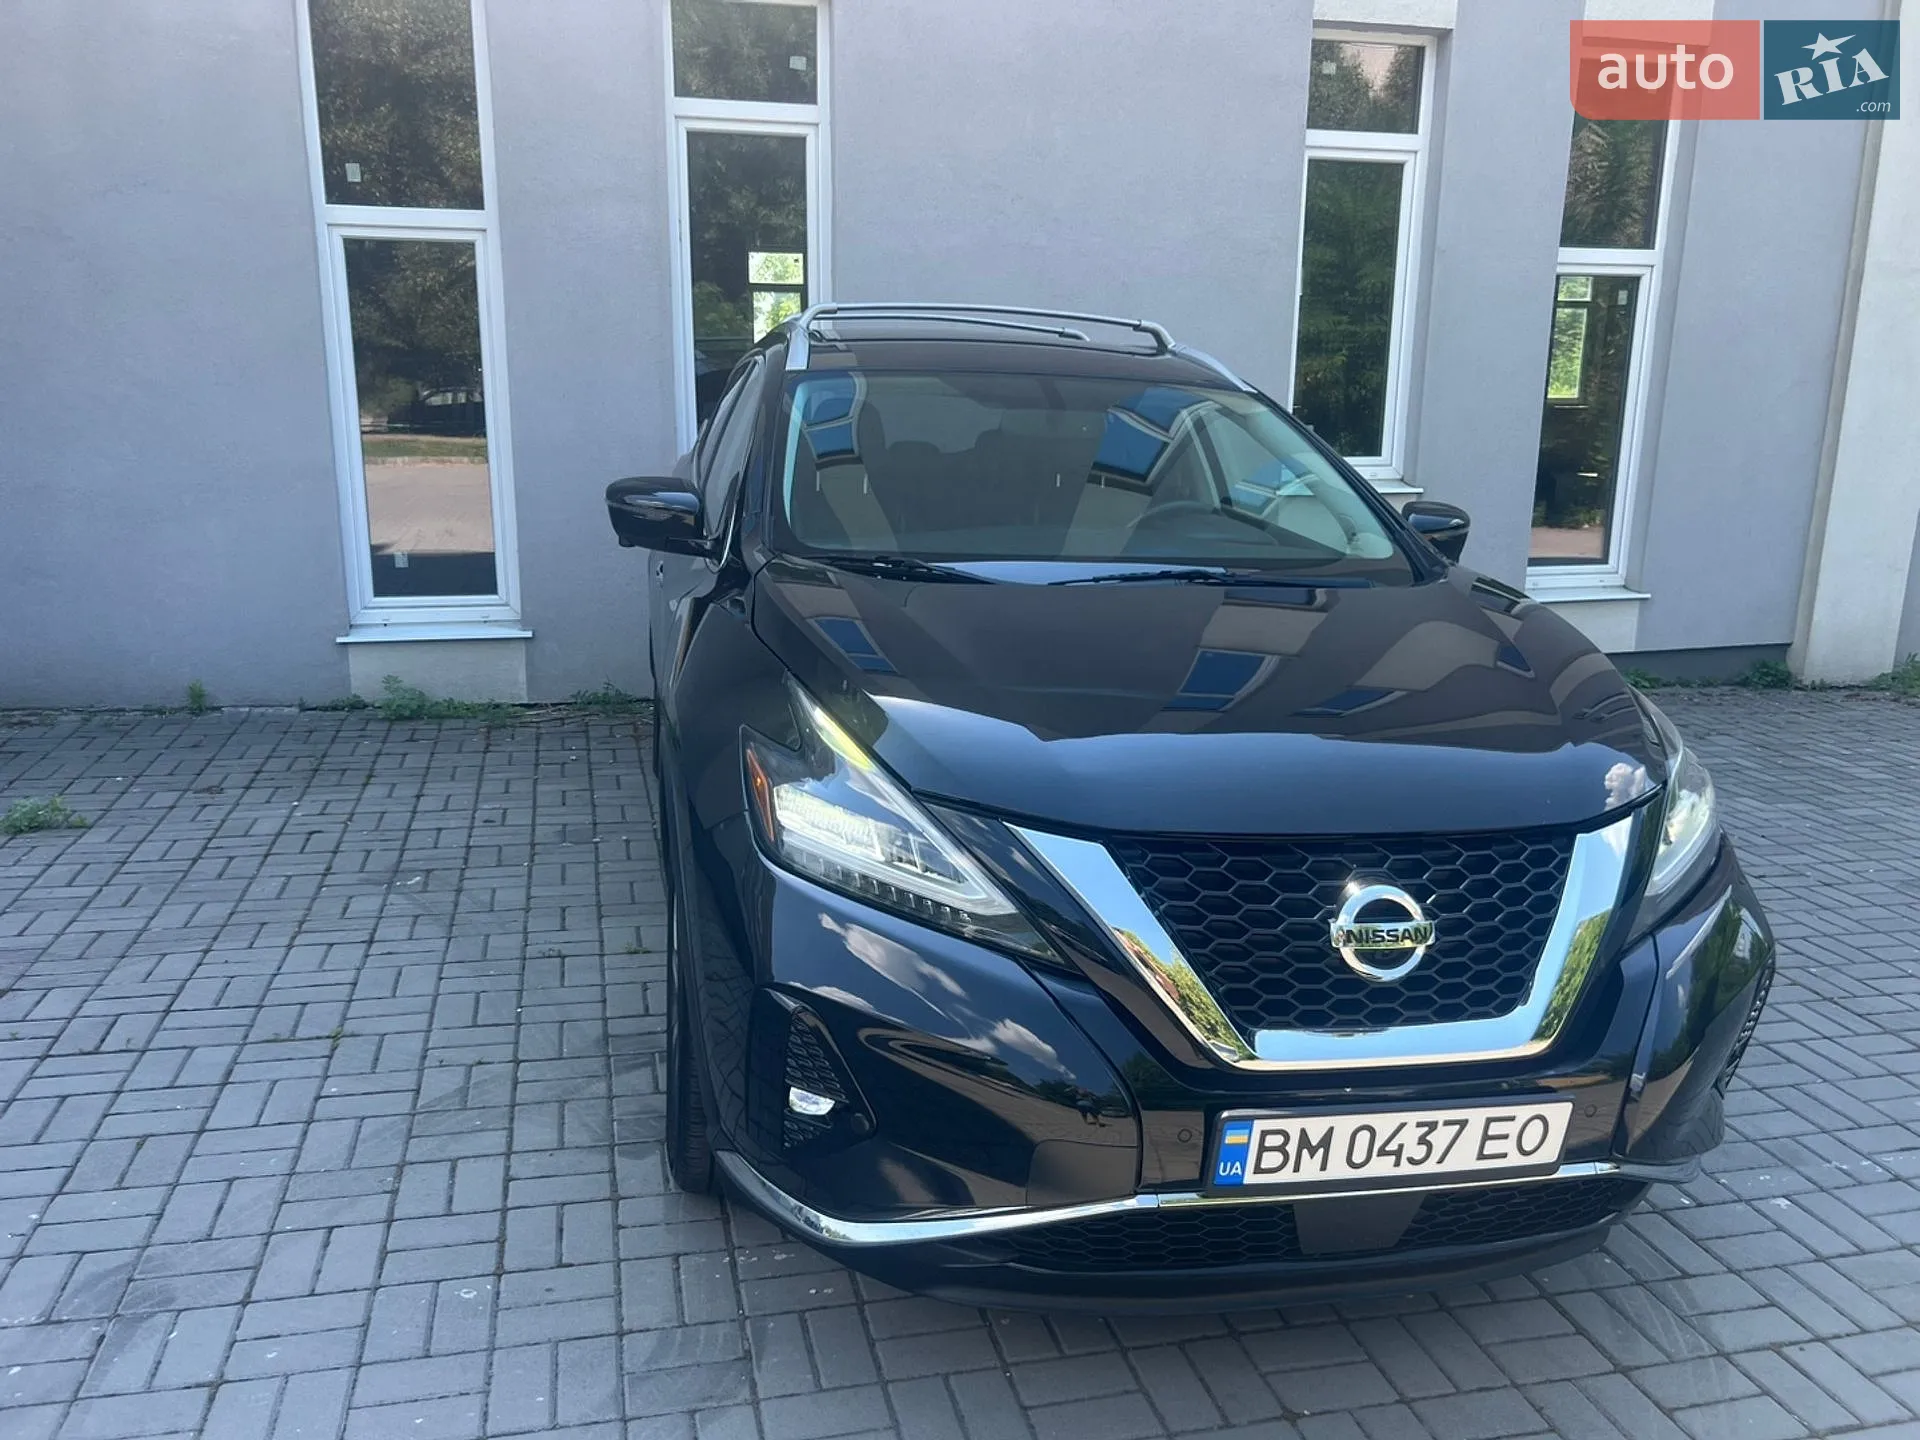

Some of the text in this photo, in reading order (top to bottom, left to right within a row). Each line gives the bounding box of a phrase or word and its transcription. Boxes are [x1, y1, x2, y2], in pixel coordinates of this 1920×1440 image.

[1343, 926, 1429, 944] NISSAN
[1252, 1113, 1550, 1175] BM 0437 EO
[1218, 1160, 1243, 1177] UA
